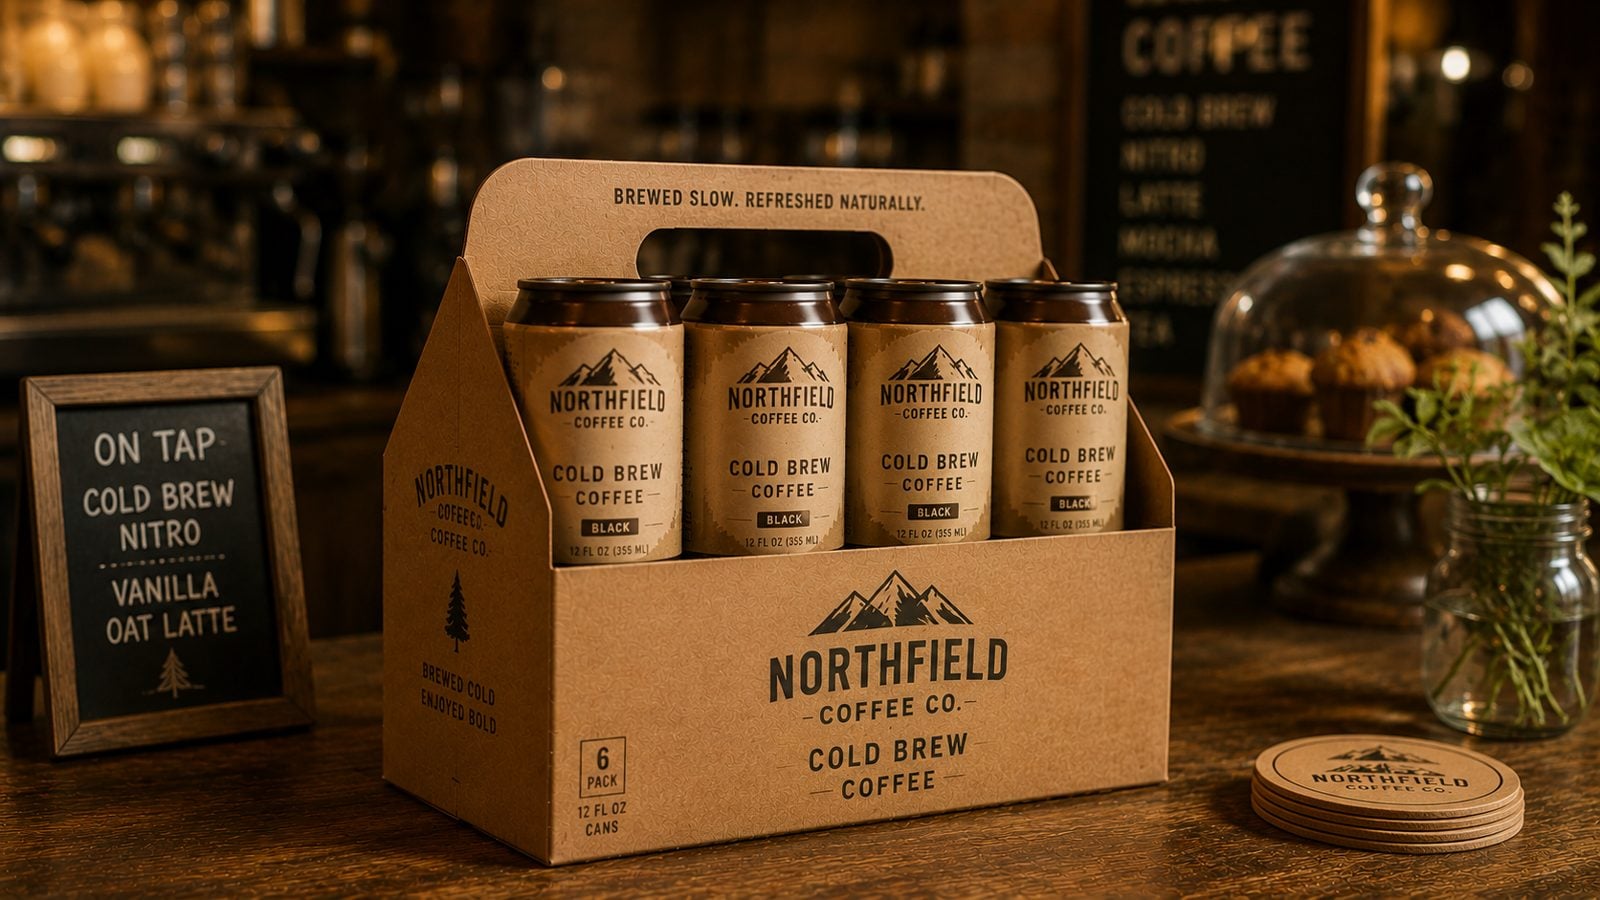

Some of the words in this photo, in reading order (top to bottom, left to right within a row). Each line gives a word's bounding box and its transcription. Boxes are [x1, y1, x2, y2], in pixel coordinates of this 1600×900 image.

[1122, 12, 1311, 74] COFFEE
[614, 188, 682, 205] BREWED
[690, 190, 739, 207] SLOW.
[746, 191, 834, 210] REFRESHED
[840, 194, 925, 211] NATURALLY.
[728, 386, 834, 410] NORTHFIELD
[881, 382, 982, 406] NORTHFIELD
[1024, 379, 1119, 402] NORTHFIELD
[550, 388, 665, 414] NORTHFIELD
[1046, 404, 1087, 416] COFFEE
[1091, 404, 1107, 415] CO.
[574, 416, 624, 429] COFFEE
[629, 416, 649, 428] CO.
[751, 412, 798, 425] COFFEE
[802, 412, 820, 424] CO.
[902, 407, 947, 420] COFFEE
[952, 407, 968, 419] CO.
[94, 431, 141, 467] ON
[153, 427, 216, 462] TAP
[1025, 447, 1069, 464] COLD
[1078, 445, 1116, 462] BREW
[729, 460, 778, 477] COLD
[787, 457, 831, 475] BREW
[881, 453, 928, 470] COLD
[937, 452, 979, 469] BREW
[553, 464, 604, 482] COLD
[614, 463, 663, 481] BREW
[1045, 469, 1101, 484] COFFEE
[751, 483, 814, 499] COFFEE
[902, 476, 962, 492] COFFEE
[83, 484, 151, 517] COLD
[162, 479, 234, 511] BREW
[414, 464, 508, 528] NORTHFIELD
[576, 489, 644, 505] COFFEE
[1059, 499, 1091, 510] BLACK
[766, 514, 802, 525] BLACK
[917, 506, 951, 518] BLACK
[120, 518, 201, 551] NITRO
[592, 522, 630, 533] BLACK
[897, 528, 907, 539] 12
[908, 528, 919, 539] FL
[921, 528, 933, 539] OZ
[430, 527, 468, 553] COFFEE
[472, 538, 489, 557] CO.
[569, 545, 580, 556] 12
[583, 546, 594, 556] FL
[597, 546, 609, 556] OZ
[745, 537, 755, 548] 12
[758, 536, 768, 547] FL
[771, 536, 783, 547] OZ
[112, 571, 219, 606] VANILLA
[106, 614, 153, 645] OAT
[163, 606, 237, 639] LATTE
[769, 638, 1008, 703] NORTHFIELD
[422, 661, 464, 694] BREWED
[468, 680, 495, 706] COLD
[421, 688, 464, 721] ENJOYED
[819, 696, 914, 725] COFFEE
[925, 693, 962, 714] CO.
[596, 746, 610, 771] 6
[809, 742, 880, 772] COLD
[894, 732, 968, 760] BREW
[587, 773, 618, 790] PACK
[841, 770, 935, 800] COFFEE
[1312, 773, 1469, 788] NORTHFIELD
[1345, 784, 1415, 792] COFFEE
[577, 804, 590, 819] 12
[594, 803, 608, 817] FL
[611, 801, 627, 816] OZ
[585, 820, 619, 837] CANS
